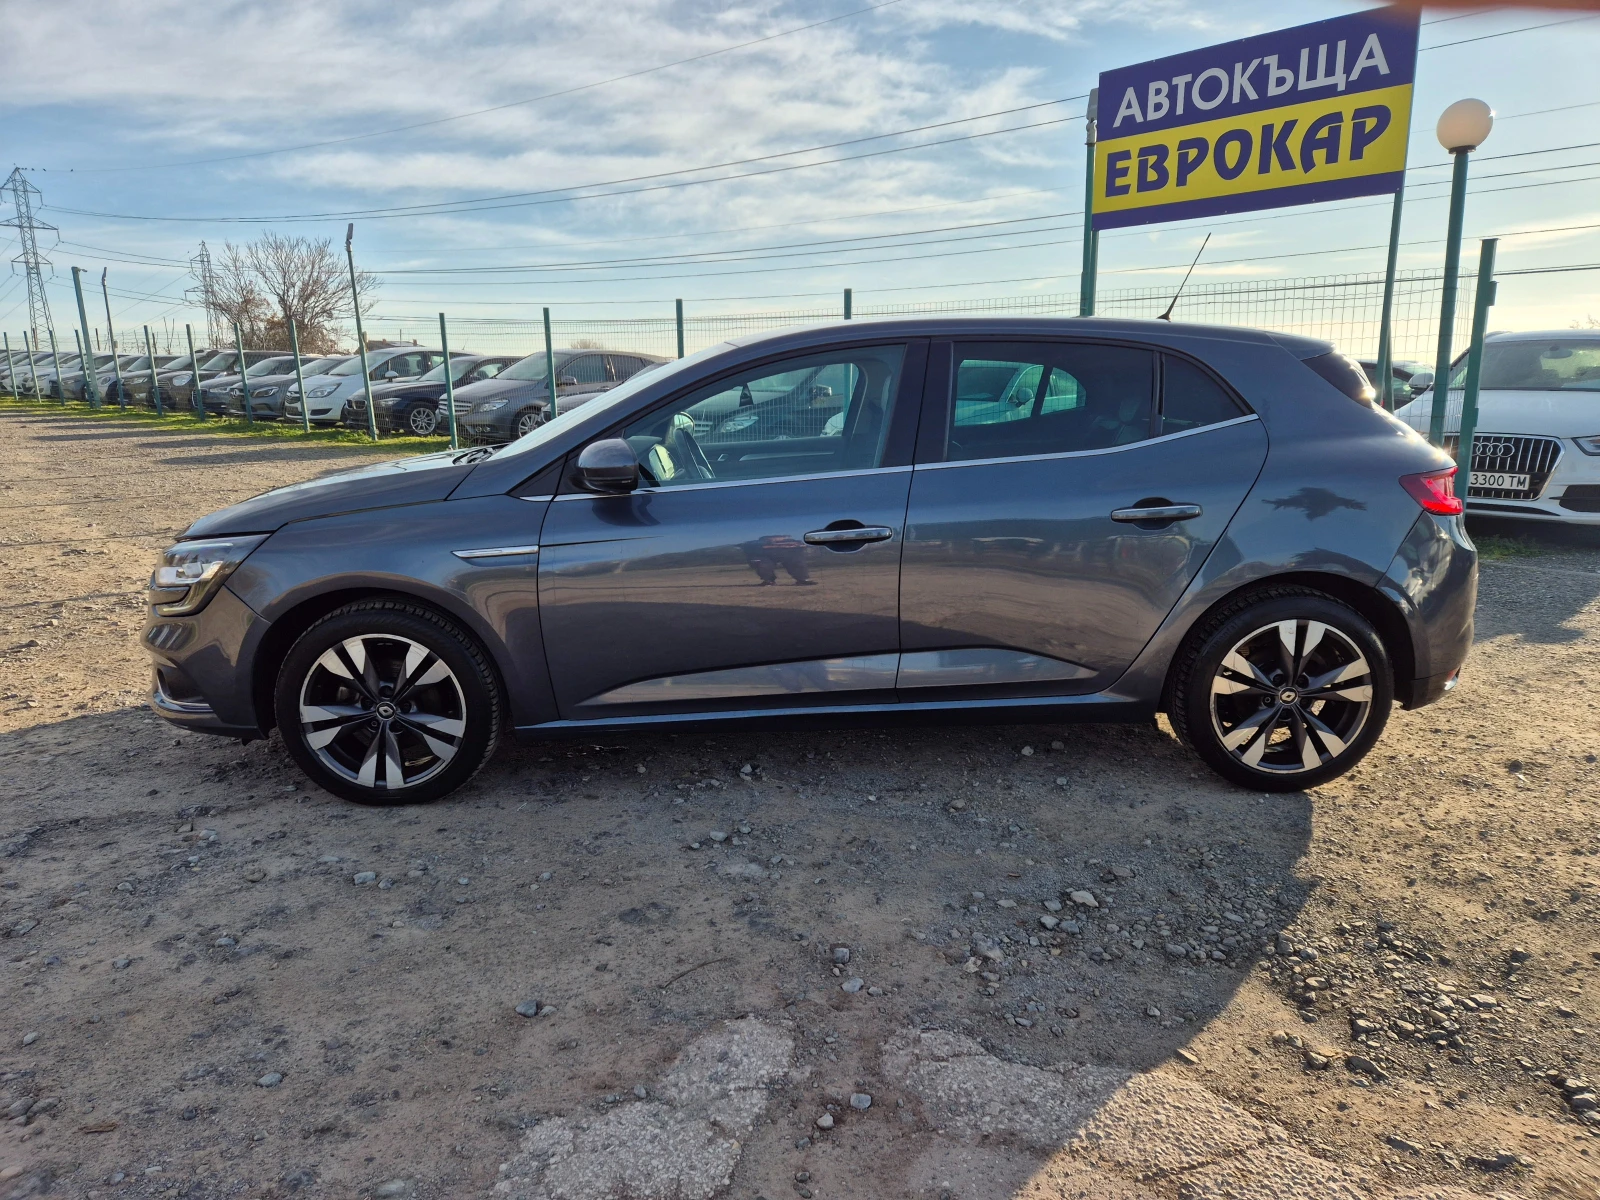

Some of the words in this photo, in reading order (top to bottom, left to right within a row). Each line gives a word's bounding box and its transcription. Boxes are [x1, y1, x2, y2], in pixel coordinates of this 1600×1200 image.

[1113, 33, 1390, 128] АВТОКЪЩА
[1105, 104, 1391, 198] ЕВРОКАР
[1470, 473, 1505, 487] 3300
